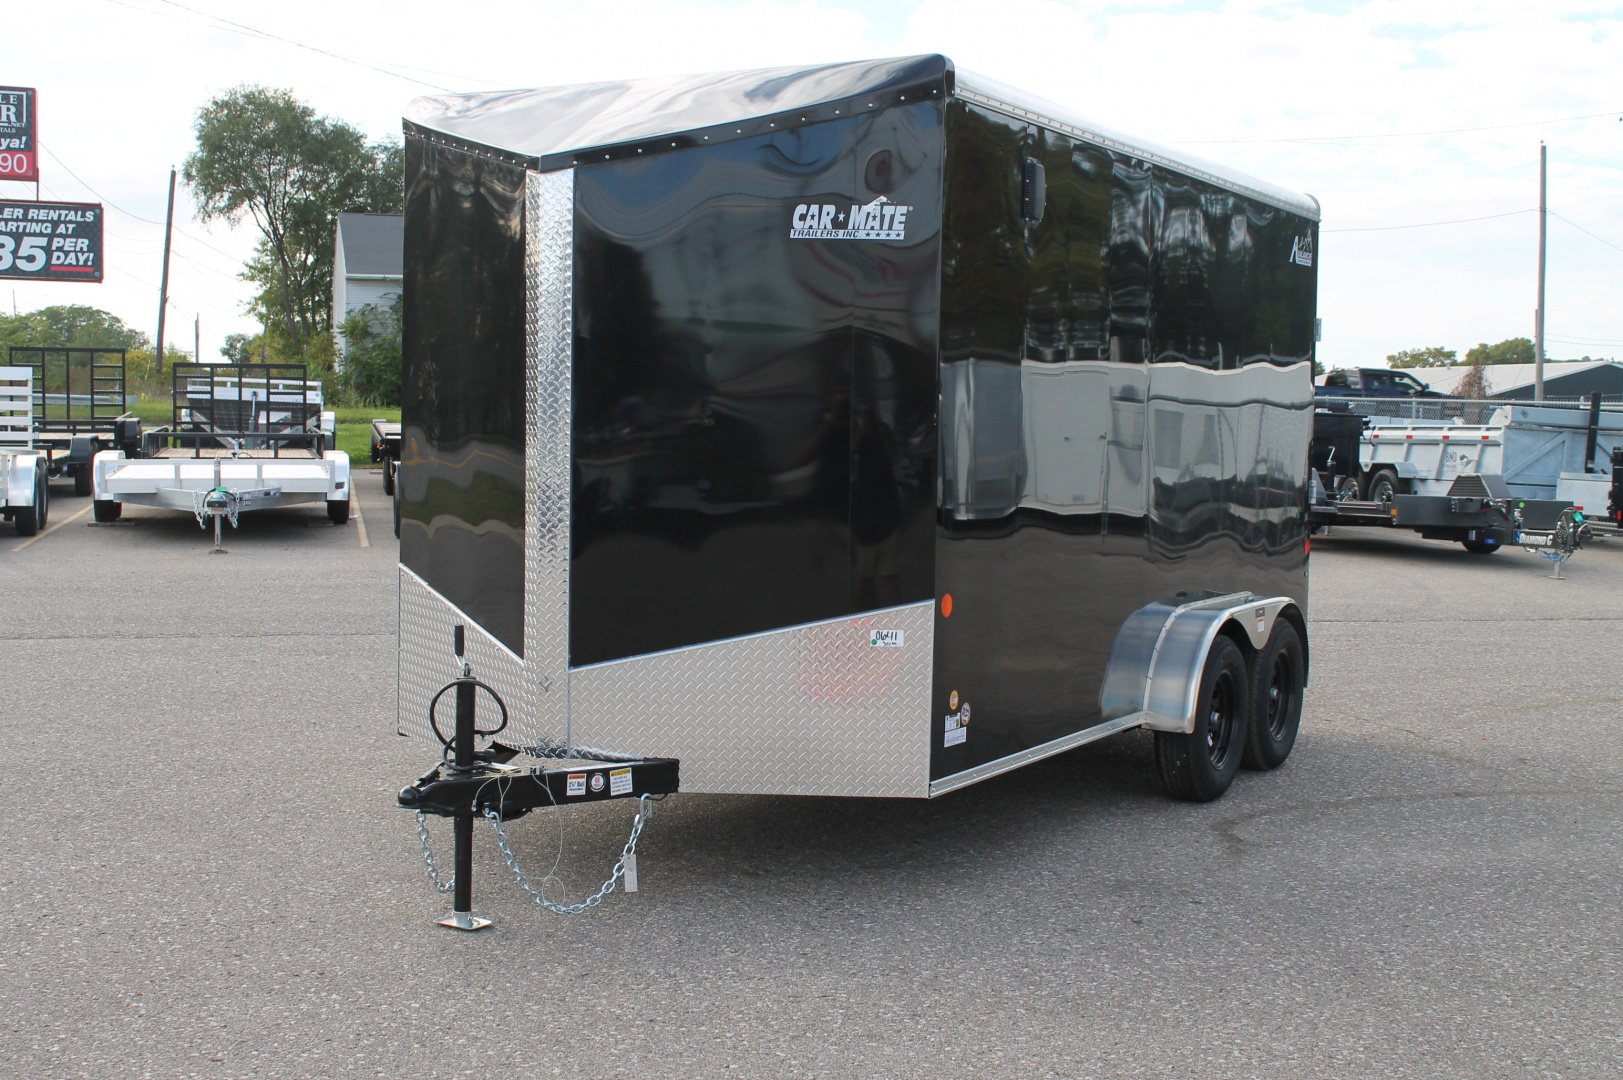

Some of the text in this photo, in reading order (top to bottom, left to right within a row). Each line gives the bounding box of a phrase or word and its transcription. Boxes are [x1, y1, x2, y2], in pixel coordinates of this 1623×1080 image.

[28, 208, 95, 222] RENTALS
[792, 204, 908, 231] CAR MATE
[55, 223, 77, 235] AT
[791, 230, 840, 238] TRAILERS
[51, 237, 90, 252] PER
[51, 251, 95, 266] DAY!
[1519, 532, 1554, 546] DIAMOND C
